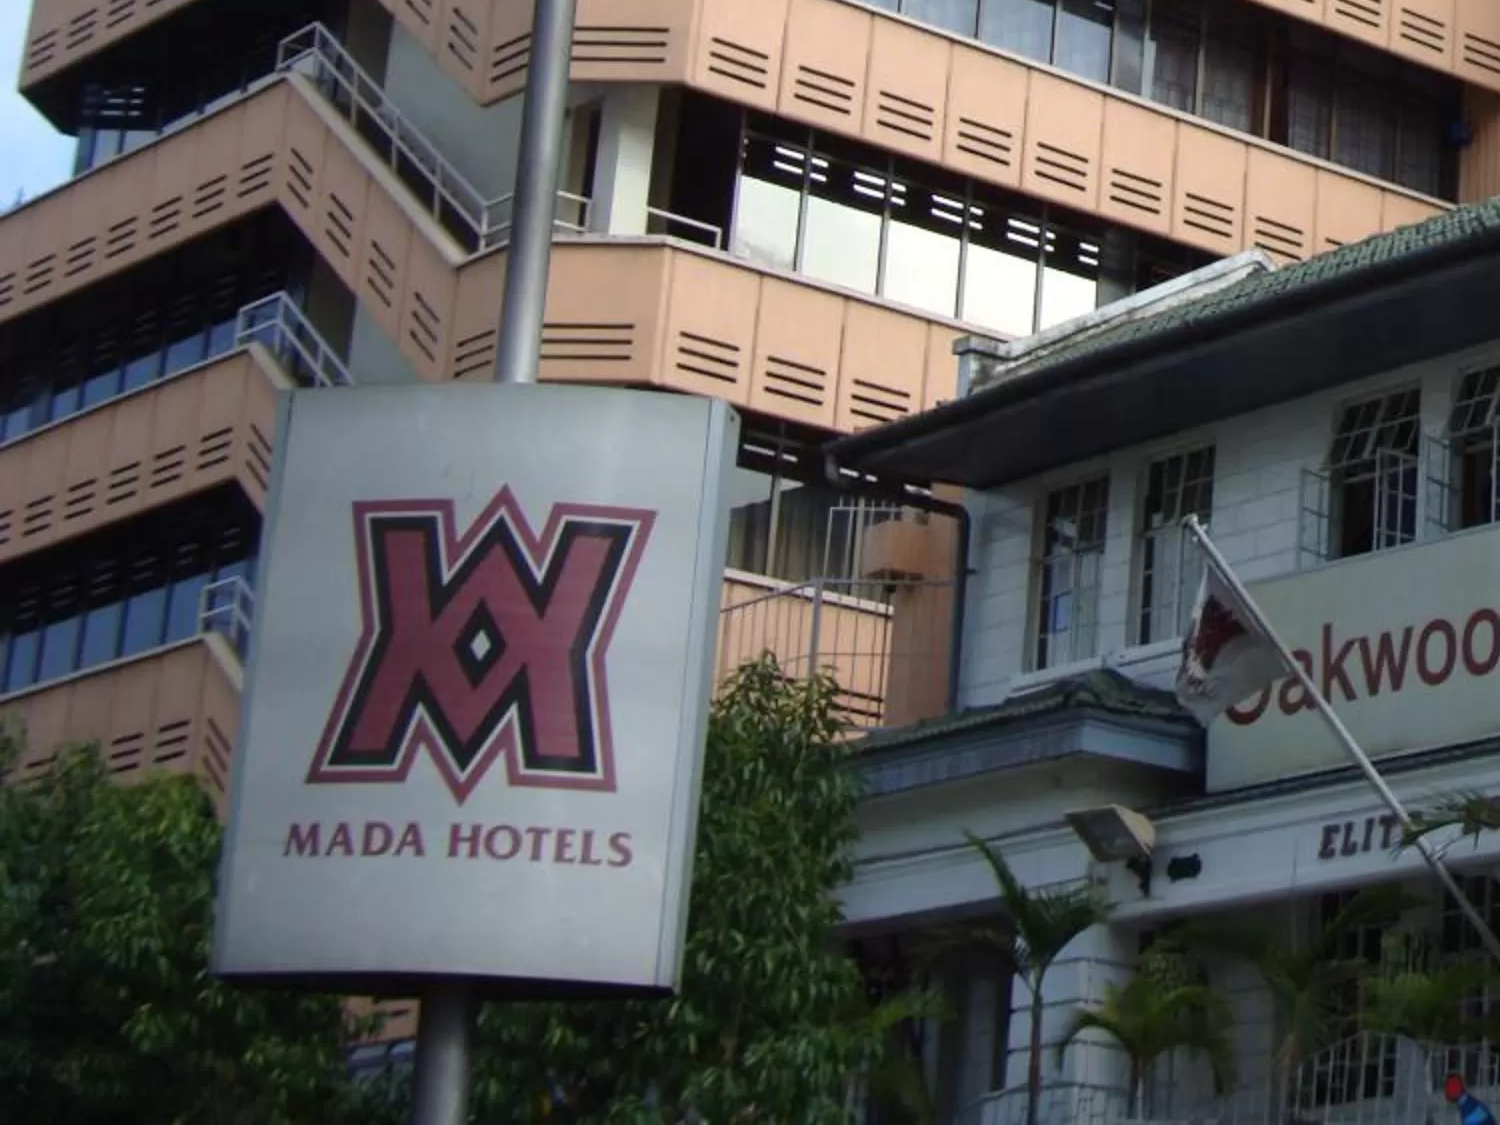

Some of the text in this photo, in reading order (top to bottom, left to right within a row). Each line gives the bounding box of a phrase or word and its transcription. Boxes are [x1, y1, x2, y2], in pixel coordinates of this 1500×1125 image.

[283, 821, 634, 867] MADA HOTELS
[1318, 810, 1424, 860] ELIT
